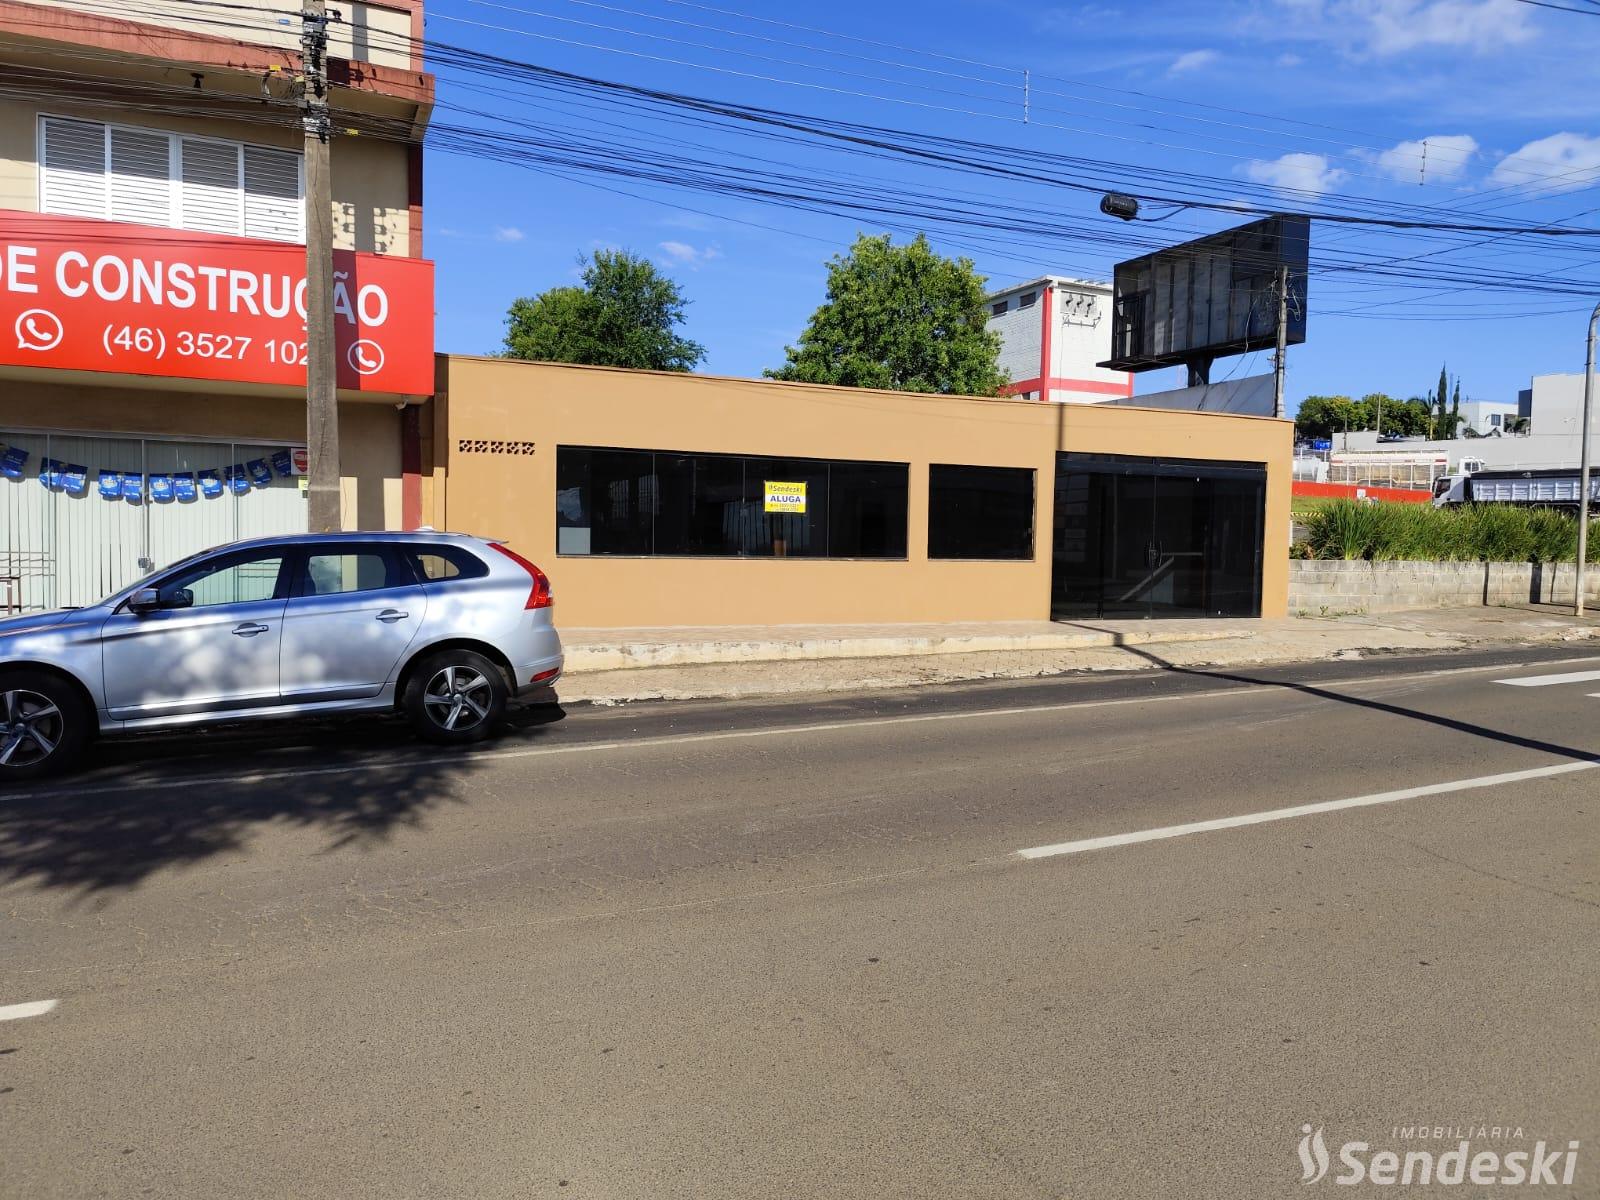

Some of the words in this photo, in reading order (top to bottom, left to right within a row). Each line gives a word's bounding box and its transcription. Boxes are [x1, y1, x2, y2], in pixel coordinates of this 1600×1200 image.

[0, 245, 38, 293] E
[102, 324, 166, 360] (46)
[176, 331, 252, 360] 3527
[770, 495, 801, 503] ALUGA
